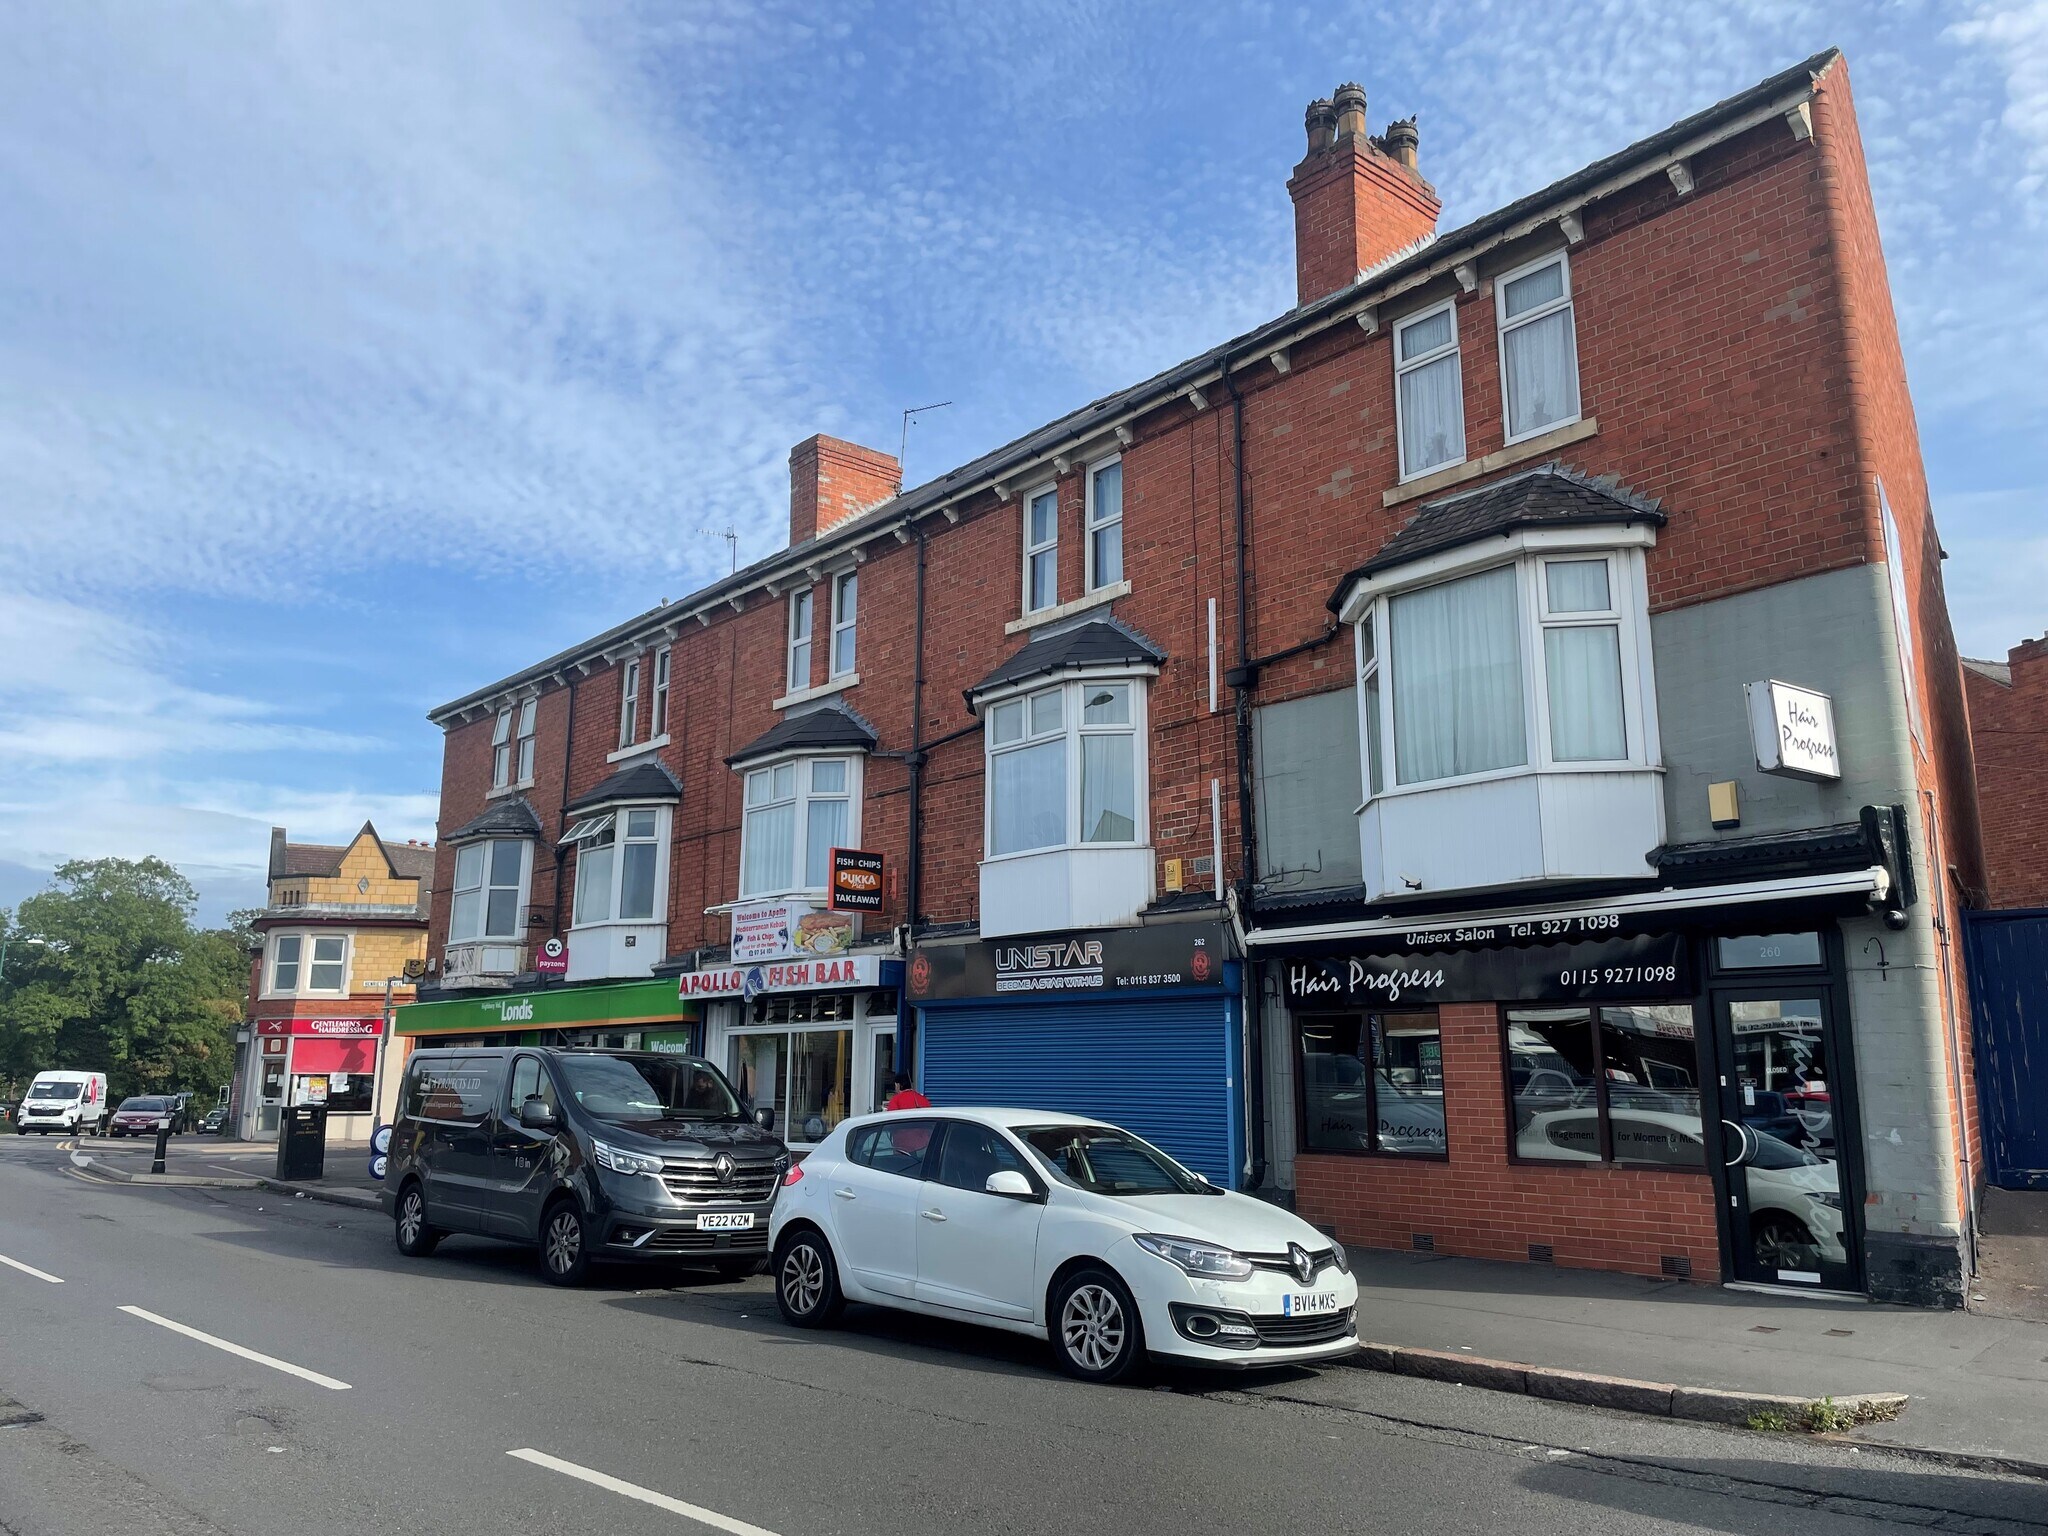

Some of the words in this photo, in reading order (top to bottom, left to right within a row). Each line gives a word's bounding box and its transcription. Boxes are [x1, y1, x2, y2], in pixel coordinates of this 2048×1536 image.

[1788, 700, 1819, 727] Hair
[1782, 724, 1835, 760] Progress
[836, 857, 854, 867] FISH
[858, 859, 881, 869] CHIPS
[840, 871, 876, 885] PUKKA
[835, 893, 880, 905] TAKEAWAY
[736, 912, 760, 921] Welcome
[768, 907, 786, 918] Apollo
[1406, 931, 1451, 945] Unisex
[1455, 928, 1495, 942] Salon
[1508, 923, 1536, 938] Tel.
[1541, 918, 1572, 935] 927
[1579, 914, 1620, 931] 1098
[761, 933, 775, 941] Chips
[1194, 938, 1205, 946] 262
[995, 940, 1103, 971] UNISTAR
[1760, 947, 1781, 958] 260
[679, 970, 741, 994] APOLLO
[769, 964, 809, 986] FISH
[815, 960, 855, 983] BAR
[1116, 976, 1129, 986] Tel:
[1130, 976, 1147, 985] 0115
[1148, 975, 1162, 984] 837
[1163, 973, 1181, 983] 3500
[1290, 964, 1342, 997] Hair
[1348, 960, 1445, 1001] Progress
[1560, 969, 1598, 985] 0115
[1604, 966, 1676, 983] 9271098
[996, 980, 1031, 991] BECOME
[1039, 977, 1064, 989] STAR
[1064, 976, 1089, 988] WITH
[1089, 975, 1103, 987] US
[500, 999, 533, 1021] Londis
[311, 1020, 361, 1030] GENTLEMEN'S
[318, 1025, 373, 1034] HAIRDRESSING
[1766, 1066, 1788, 1074] CLOSED
[467, 1078, 481, 1089] LTD
[1320, 1116, 1354, 1132] Hair
[1379, 1119, 1443, 1143] Progress
[1617, 1131, 1630, 1142] for
[1634, 1132, 1667, 1143] Women
[1669, 1133, 1677, 1142] &
[702, 1215, 729, 1227] YE22
[730, 1214, 750, 1227] KZM
[1294, 1294, 1317, 1311] BV14
[1319, 1293, 1336, 1310] MXS
